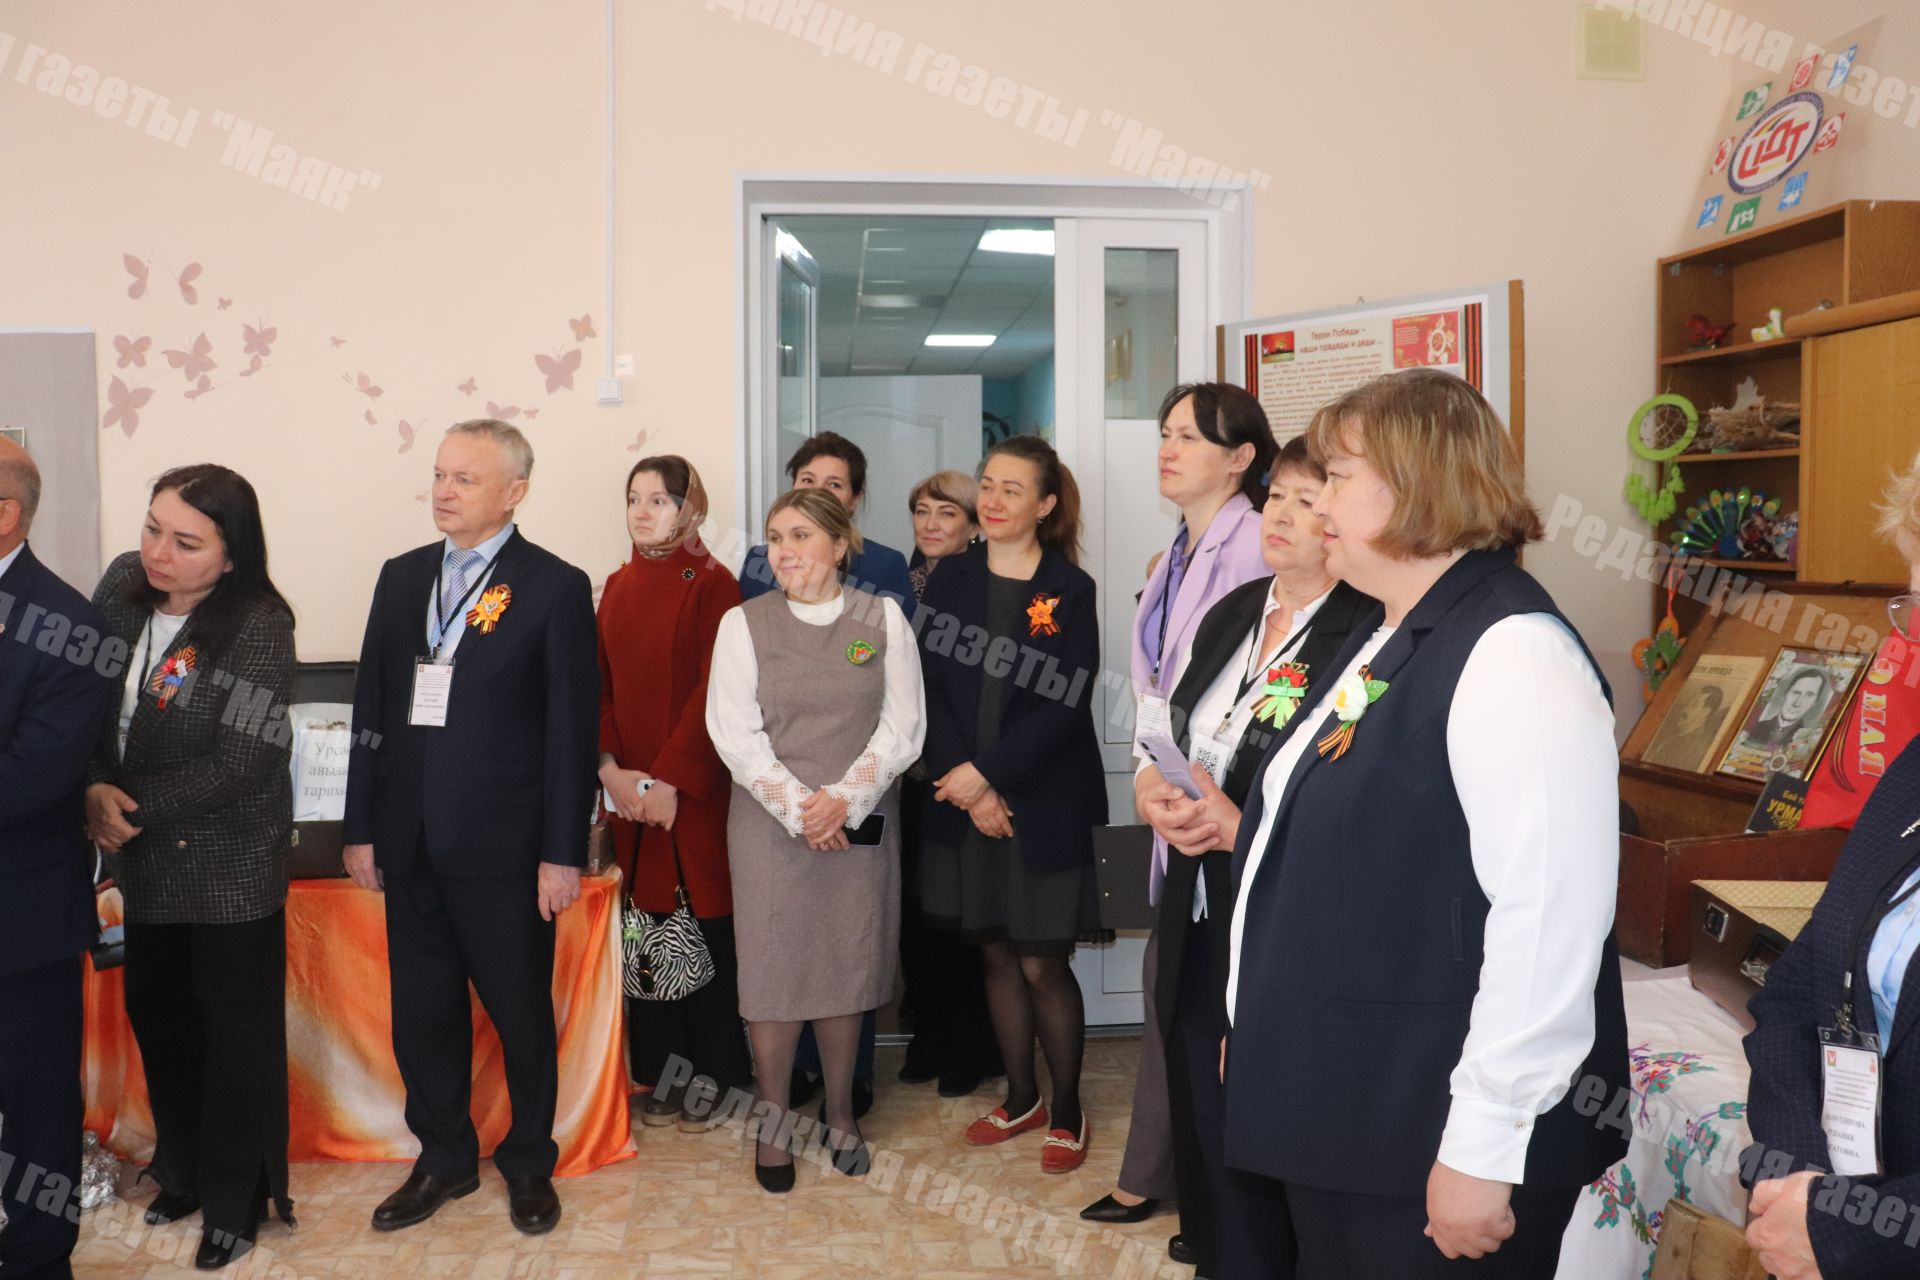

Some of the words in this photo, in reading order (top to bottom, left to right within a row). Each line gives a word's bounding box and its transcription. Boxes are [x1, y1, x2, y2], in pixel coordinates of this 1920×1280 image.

[1737, 118, 1810, 179] ЦДТ
[314, 742, 350, 759] Урса
[1858, 690, 1887, 777] МАЯ
